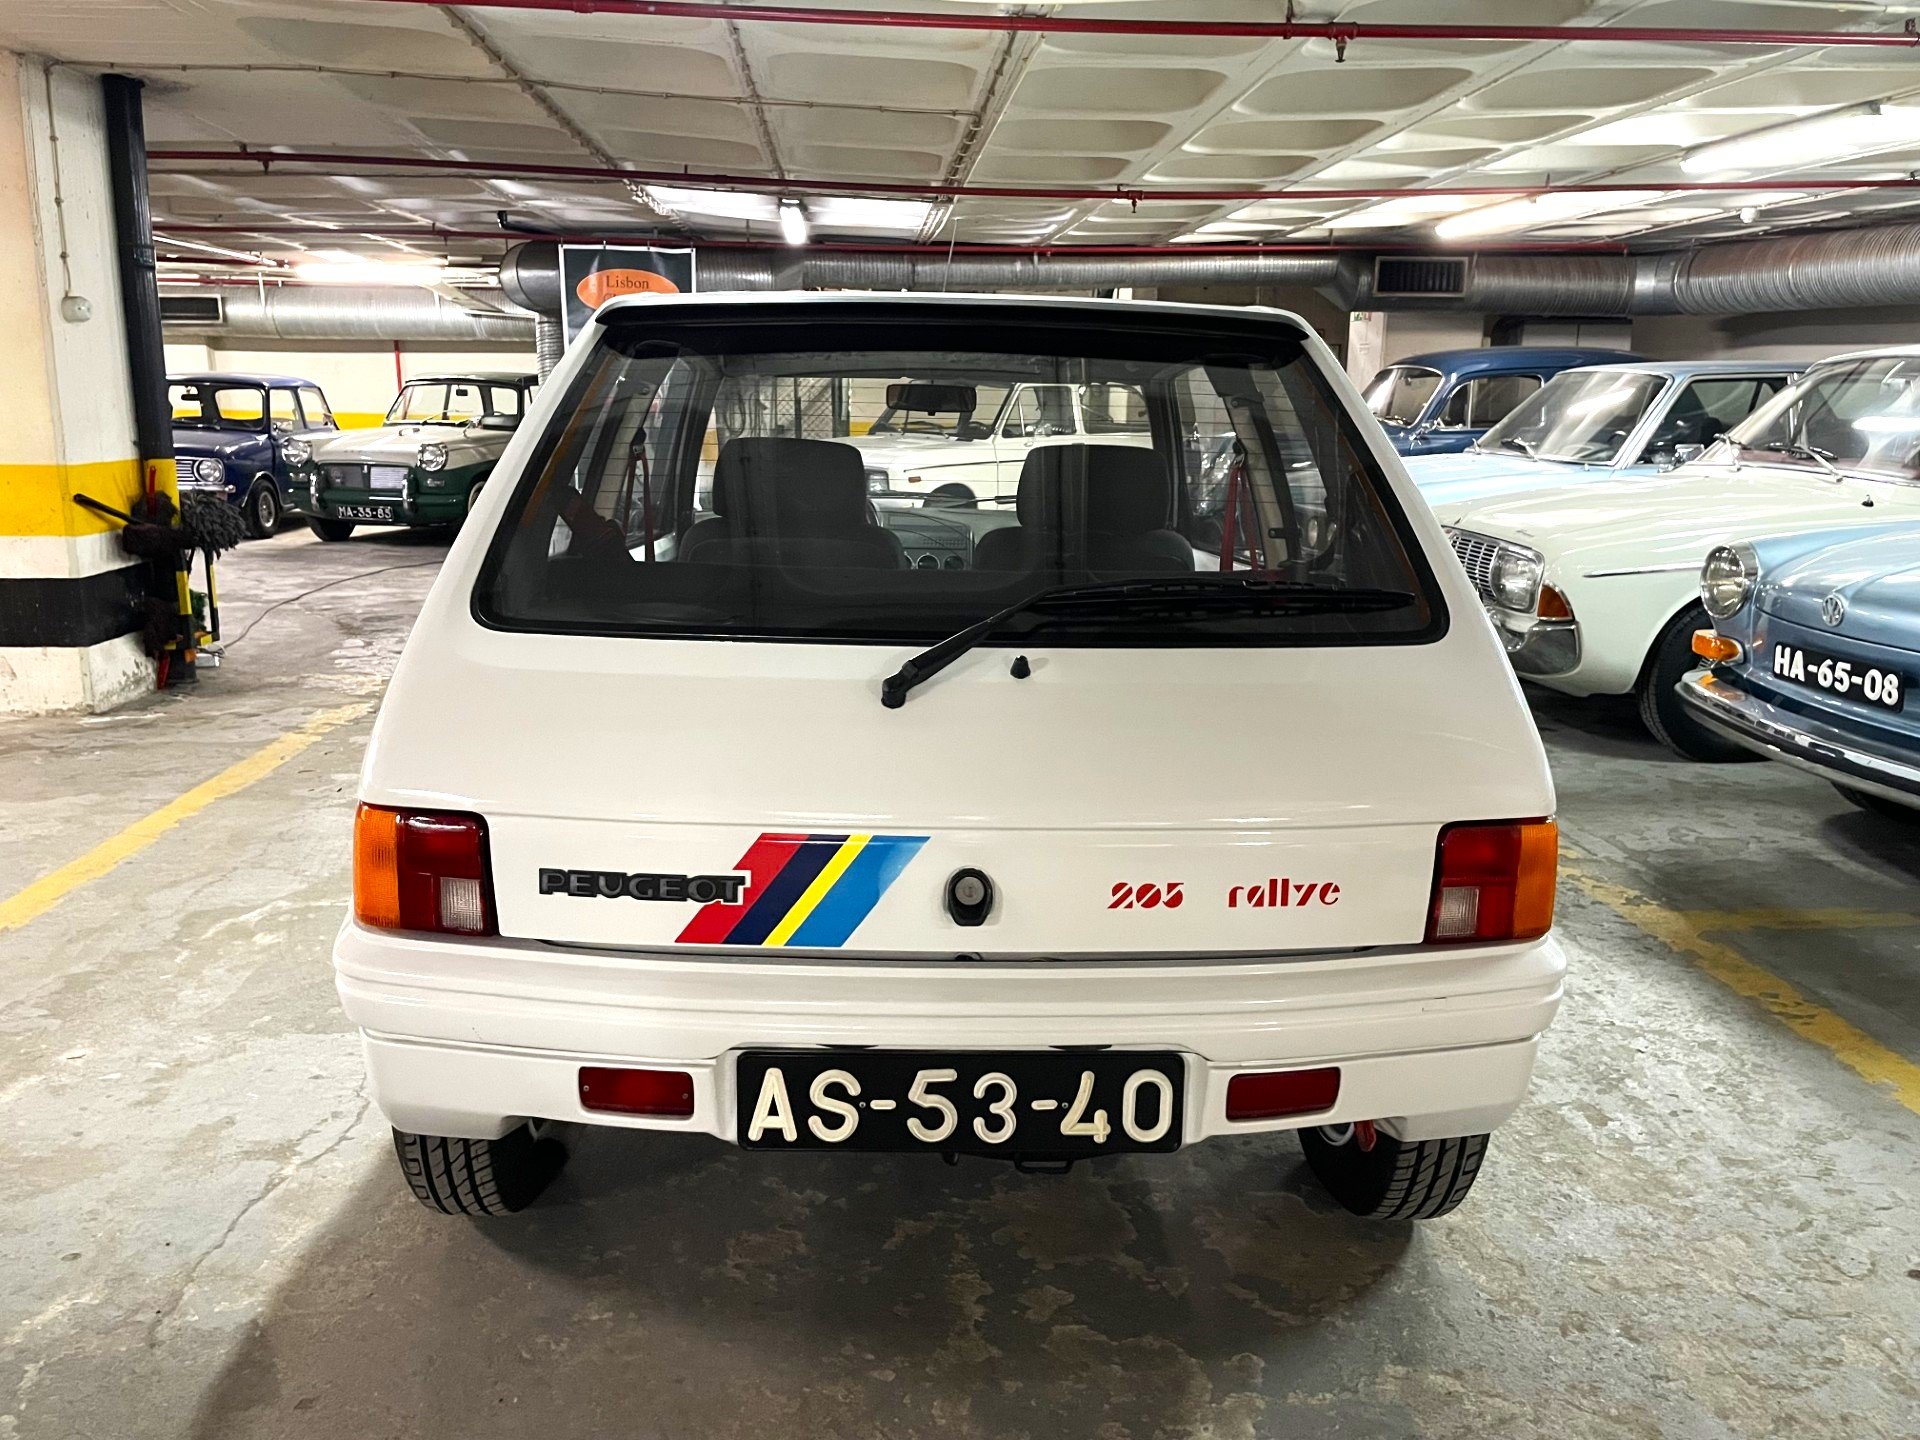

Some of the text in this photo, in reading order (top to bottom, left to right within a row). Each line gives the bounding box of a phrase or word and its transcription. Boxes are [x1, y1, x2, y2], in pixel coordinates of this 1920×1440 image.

[605, 274, 650, 290] Lisbon
[1774, 644, 1899, 706] HA-65-08
[539, 868, 746, 903] PEUGEOT
[1107, 878, 1341, 909] 205 rallye
[748, 1067, 1174, 1143] AS-53-40
